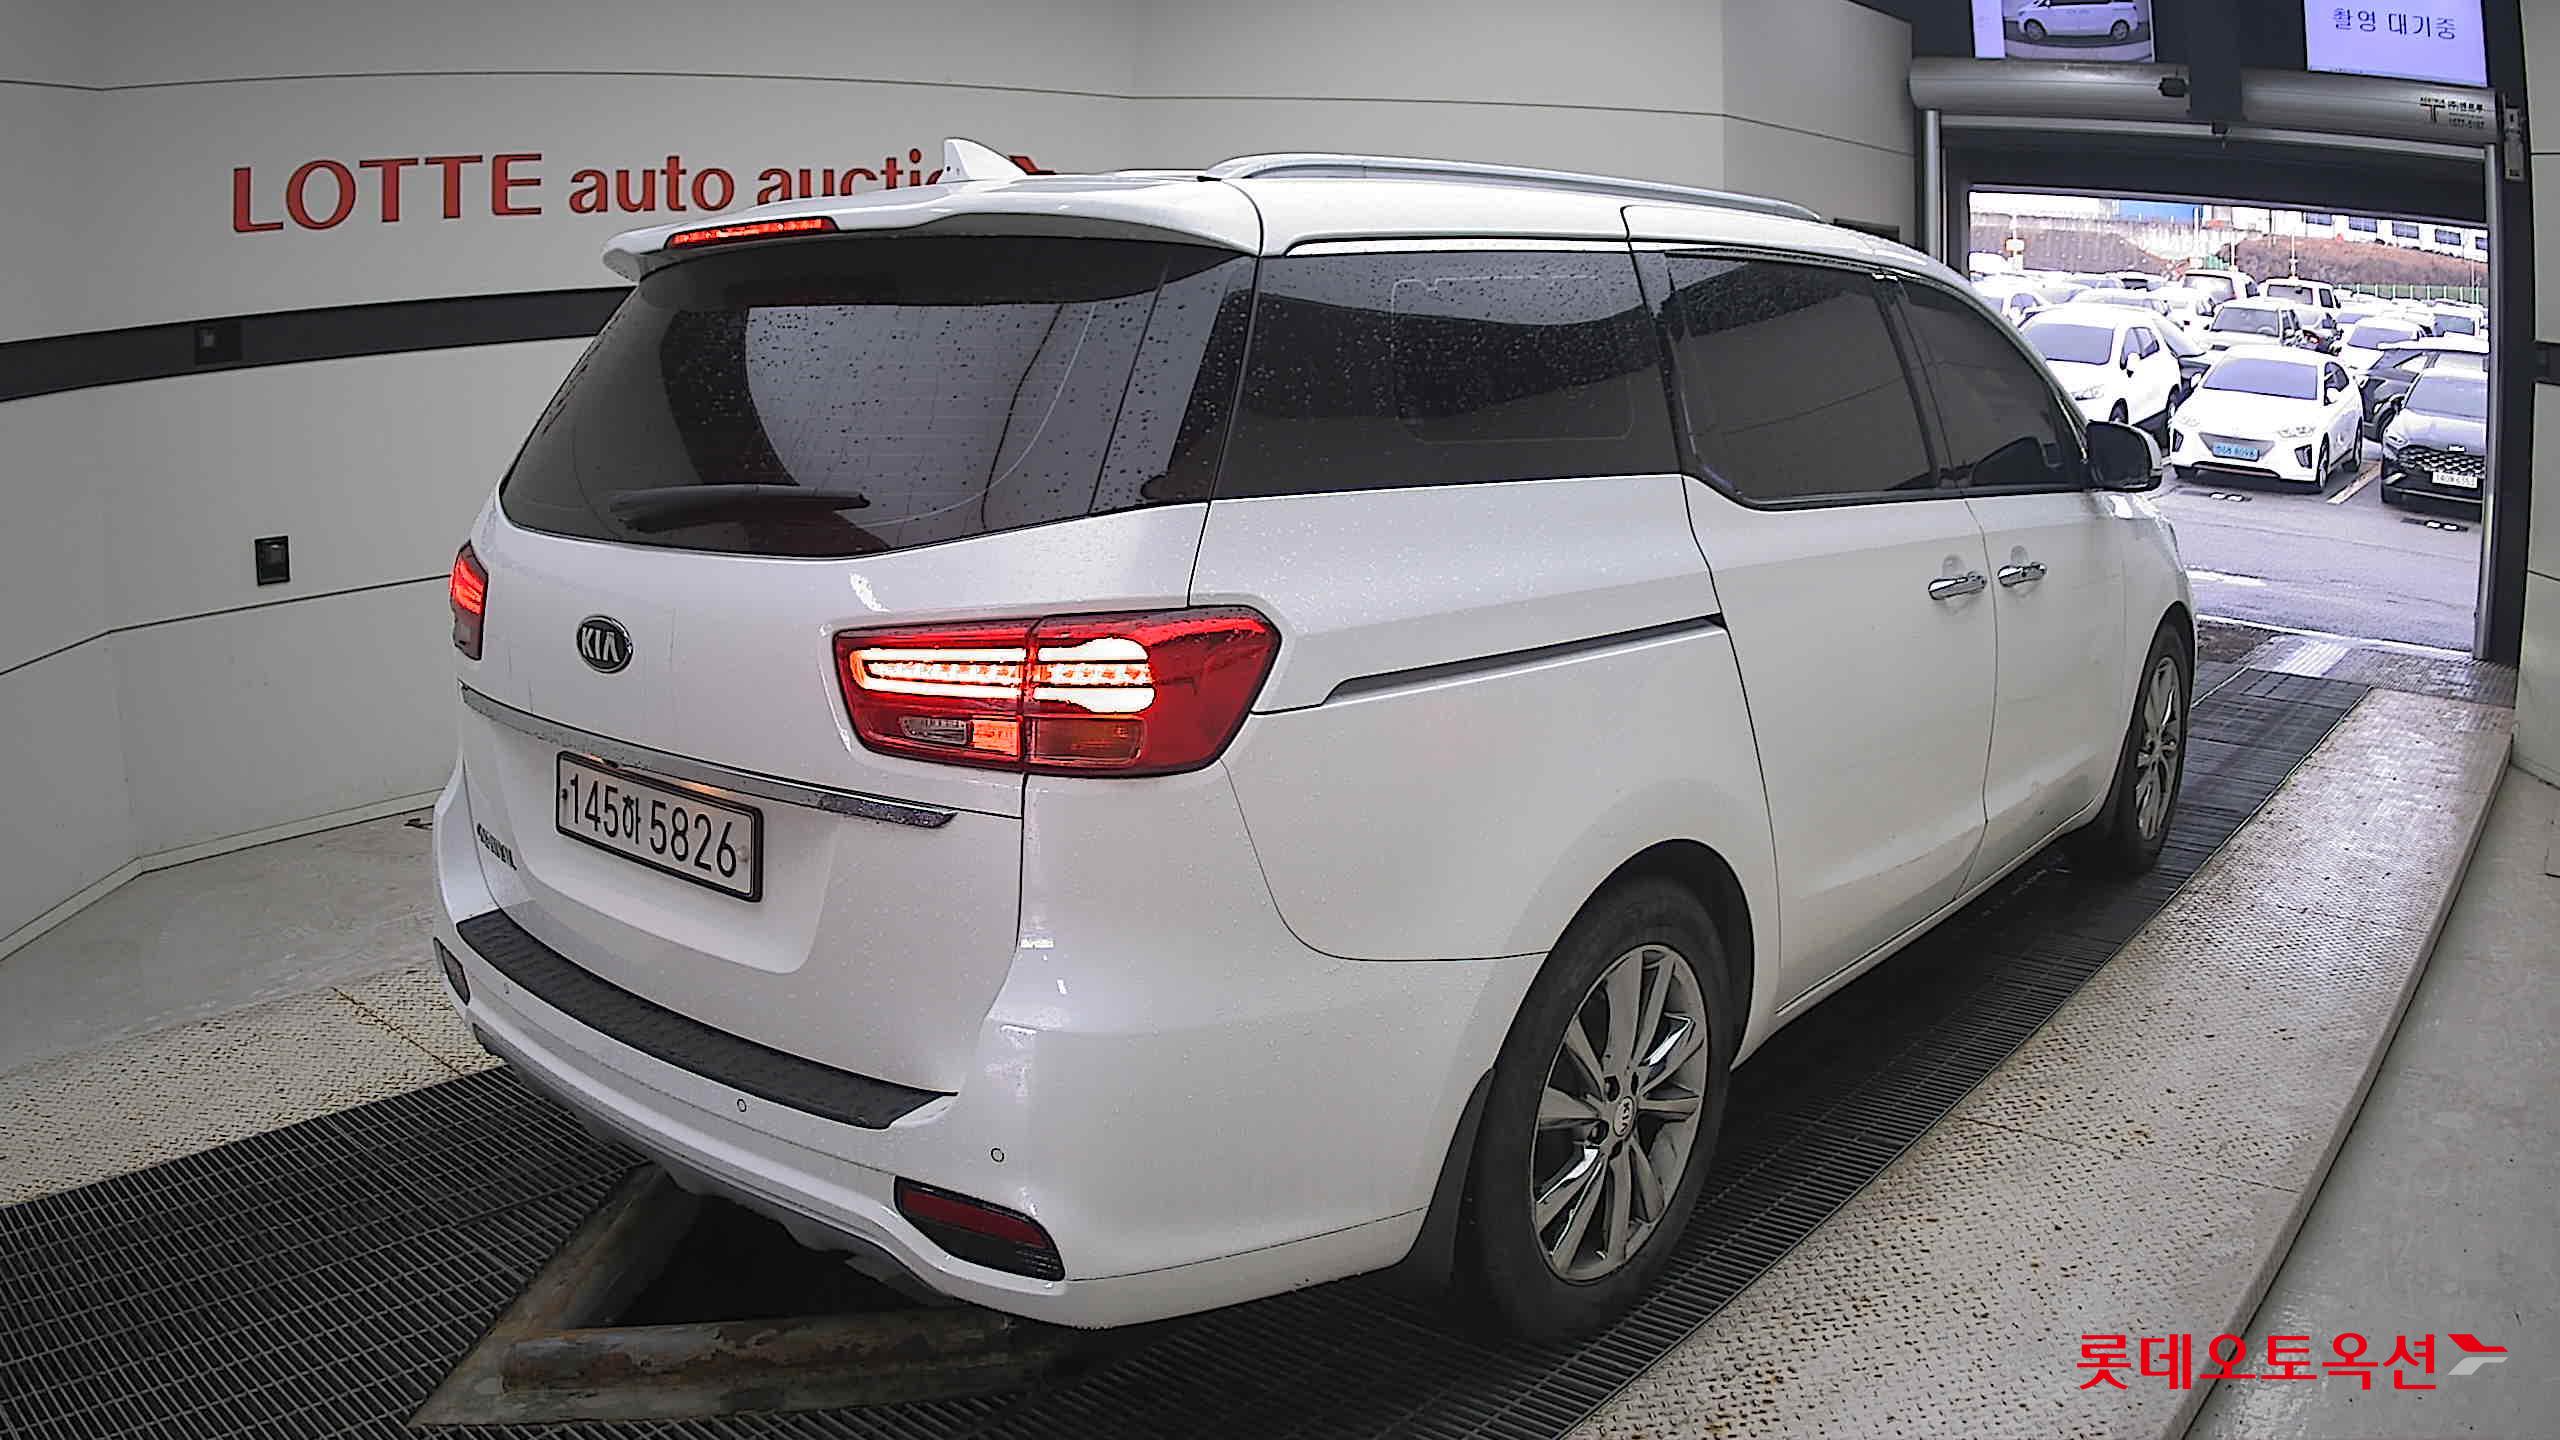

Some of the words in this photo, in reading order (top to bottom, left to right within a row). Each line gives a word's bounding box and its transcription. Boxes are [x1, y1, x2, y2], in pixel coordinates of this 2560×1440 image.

[2388, 13, 2455, 39] 대기중
[232, 152, 542, 234] LOTTE
[568, 155, 735, 214] auto
[570, 773, 641, 845] 145하
[650, 800, 736, 878] 5826
